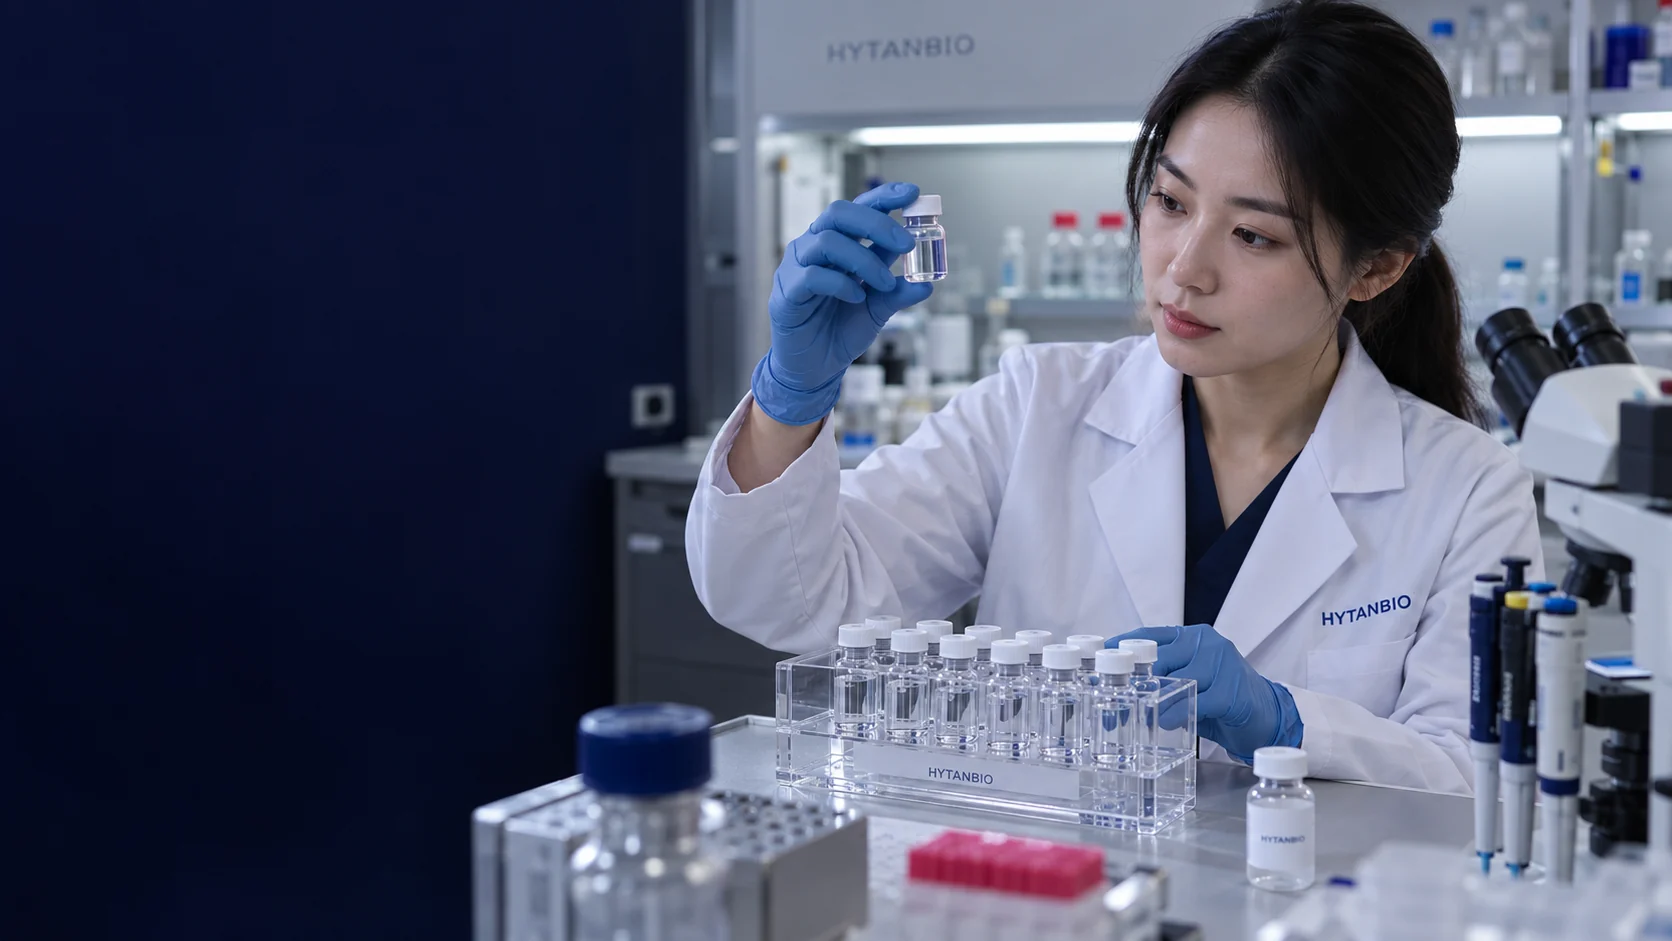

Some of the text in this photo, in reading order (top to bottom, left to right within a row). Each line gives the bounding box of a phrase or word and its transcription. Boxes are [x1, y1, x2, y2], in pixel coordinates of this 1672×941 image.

[827, 34, 975, 63] HYTANBIO
[1322, 594, 1412, 626] HYTANBIO
[928, 767, 994, 785] HYTANBIO
